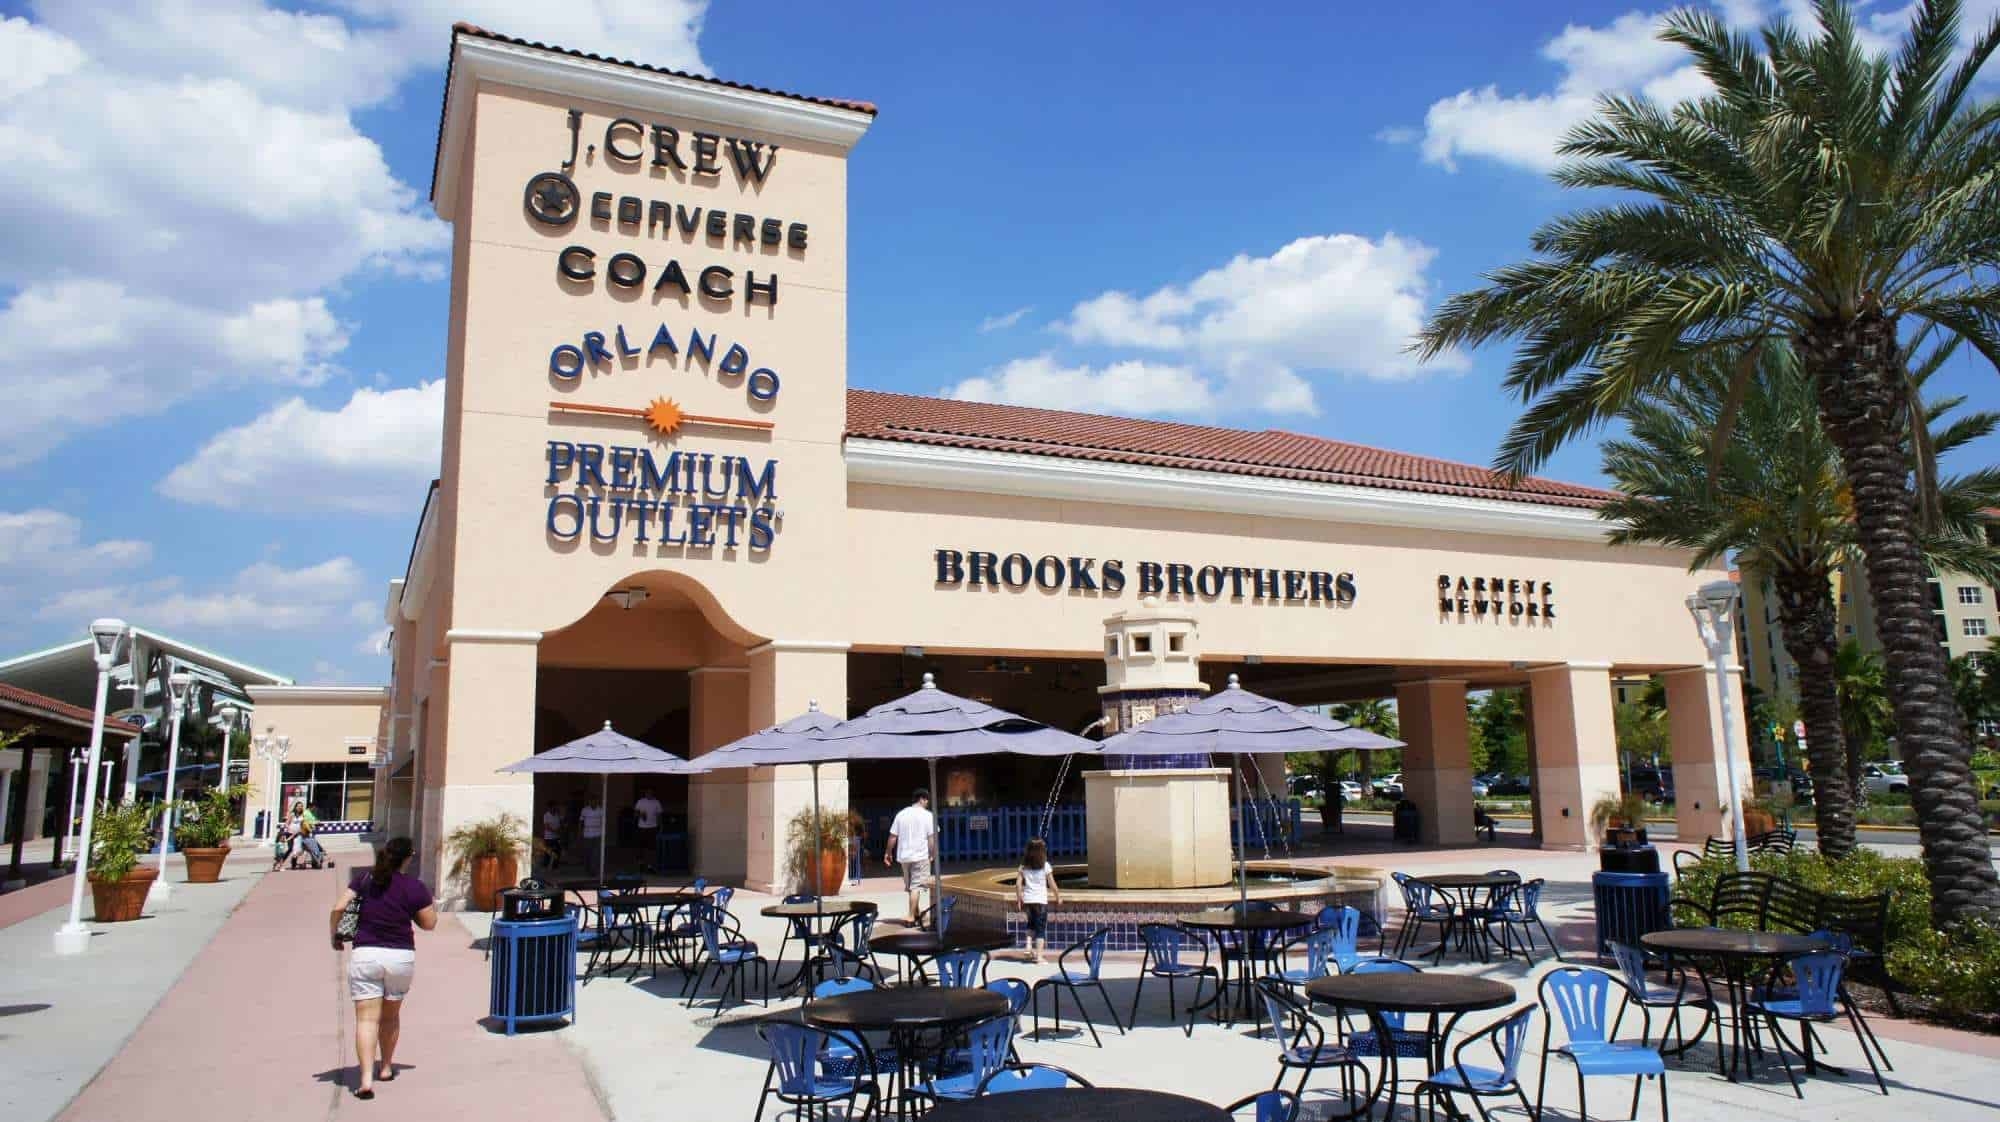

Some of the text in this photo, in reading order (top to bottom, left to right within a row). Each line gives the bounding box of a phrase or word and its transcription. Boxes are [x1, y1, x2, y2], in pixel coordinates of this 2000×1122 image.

[592, 192, 808, 249] CONVERSE
[559, 246, 778, 305] COACH
[550, 323, 780, 400] ORLANDO
[546, 441, 778, 500] PREMIUM
[548, 495, 775, 550] OUTLETS
[935, 548, 1357, 604] BROOKS BROTHERS
[1438, 574, 1553, 595] BARNEYS
